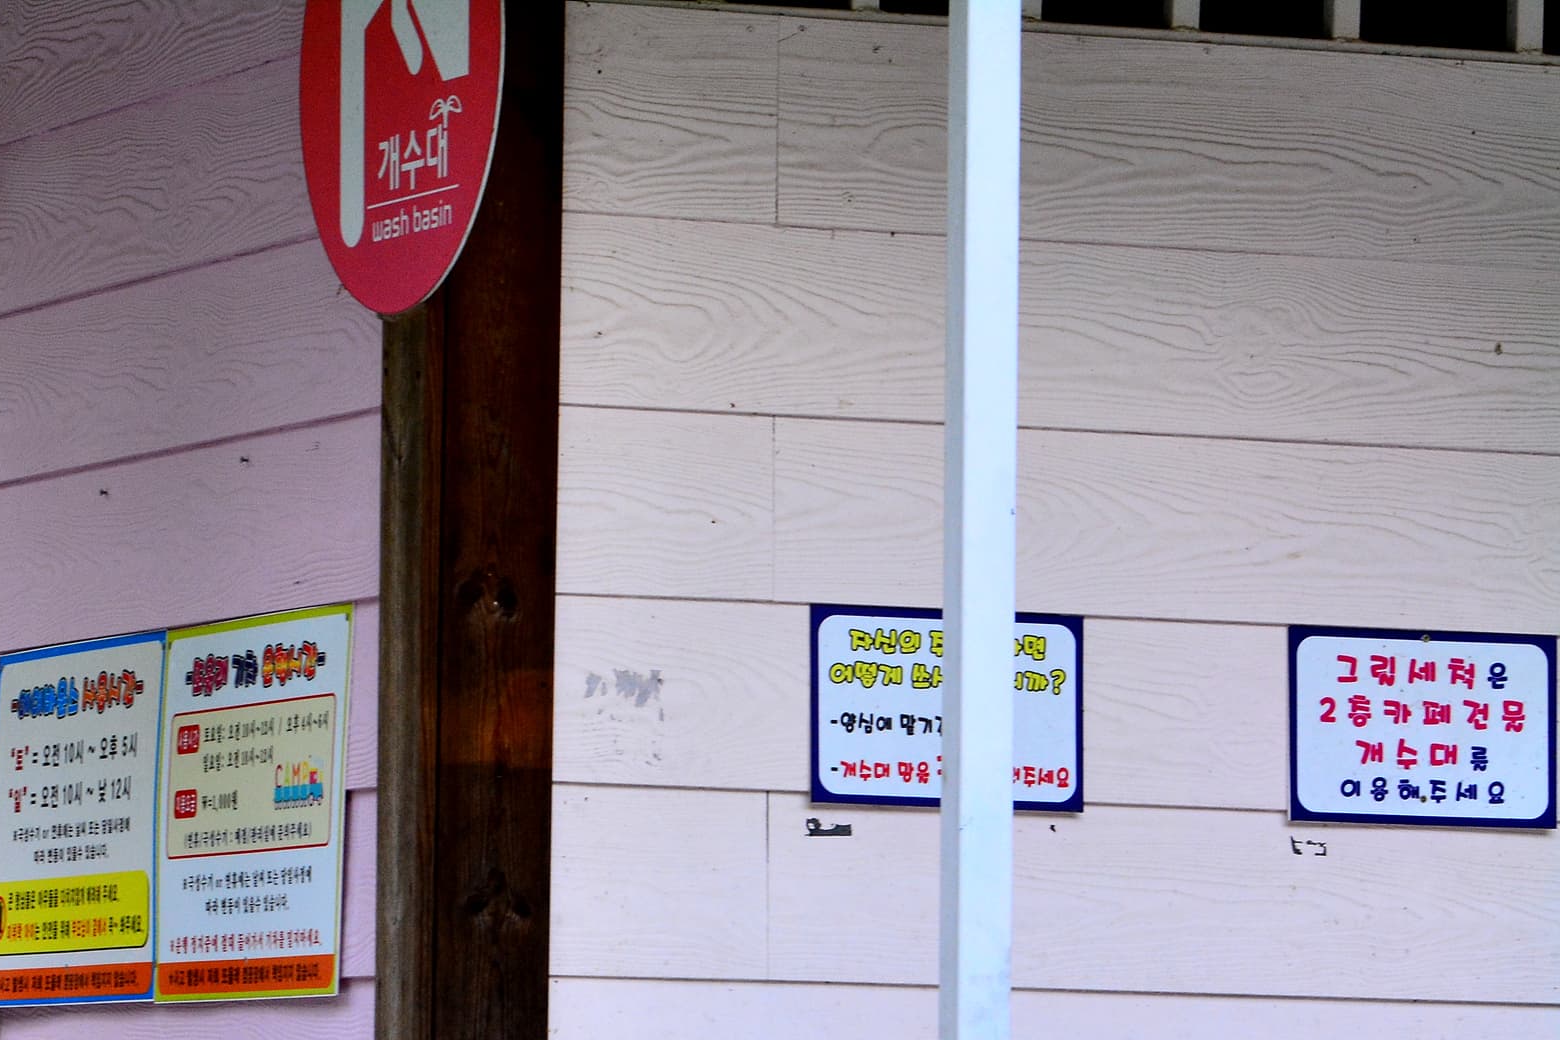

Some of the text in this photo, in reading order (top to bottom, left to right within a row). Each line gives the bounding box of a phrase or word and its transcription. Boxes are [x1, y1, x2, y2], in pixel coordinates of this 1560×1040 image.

[378, 125, 448, 190] 개수대
[372, 200, 452, 242] wash basin
[849, 628, 921, 654] 자신의
[829, 661, 903, 688] 어떻게
[41, 744, 61, 767] 오전
[63, 742, 84, 765] 10시
[99, 735, 117, 761] 오후
[121, 732, 138, 758] 5시
[898, 761, 930, 784] 망을
[40, 785, 59, 809] 오전
[62, 782, 83, 806] 10시
[98, 779, 106, 804] 낮
[110, 776, 132, 800] 12시
